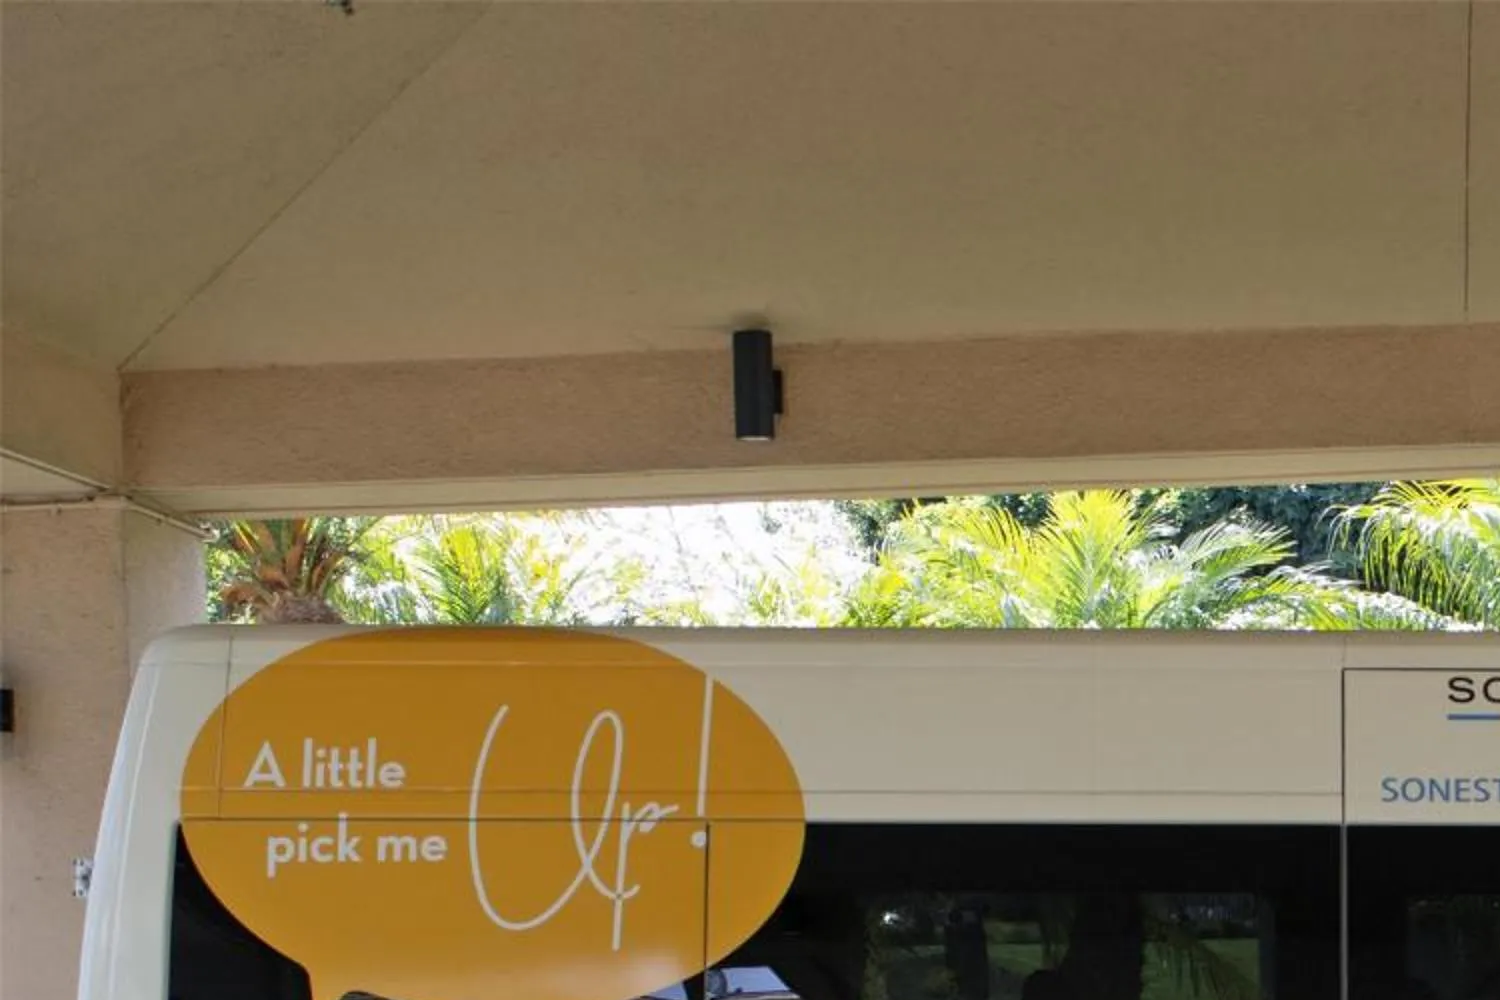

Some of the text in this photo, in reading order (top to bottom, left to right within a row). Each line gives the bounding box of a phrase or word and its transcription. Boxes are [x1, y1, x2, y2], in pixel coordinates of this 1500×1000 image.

[243, 738, 406, 790] A little
[266, 812, 361, 878] pick
[377, 834, 448, 863] me
